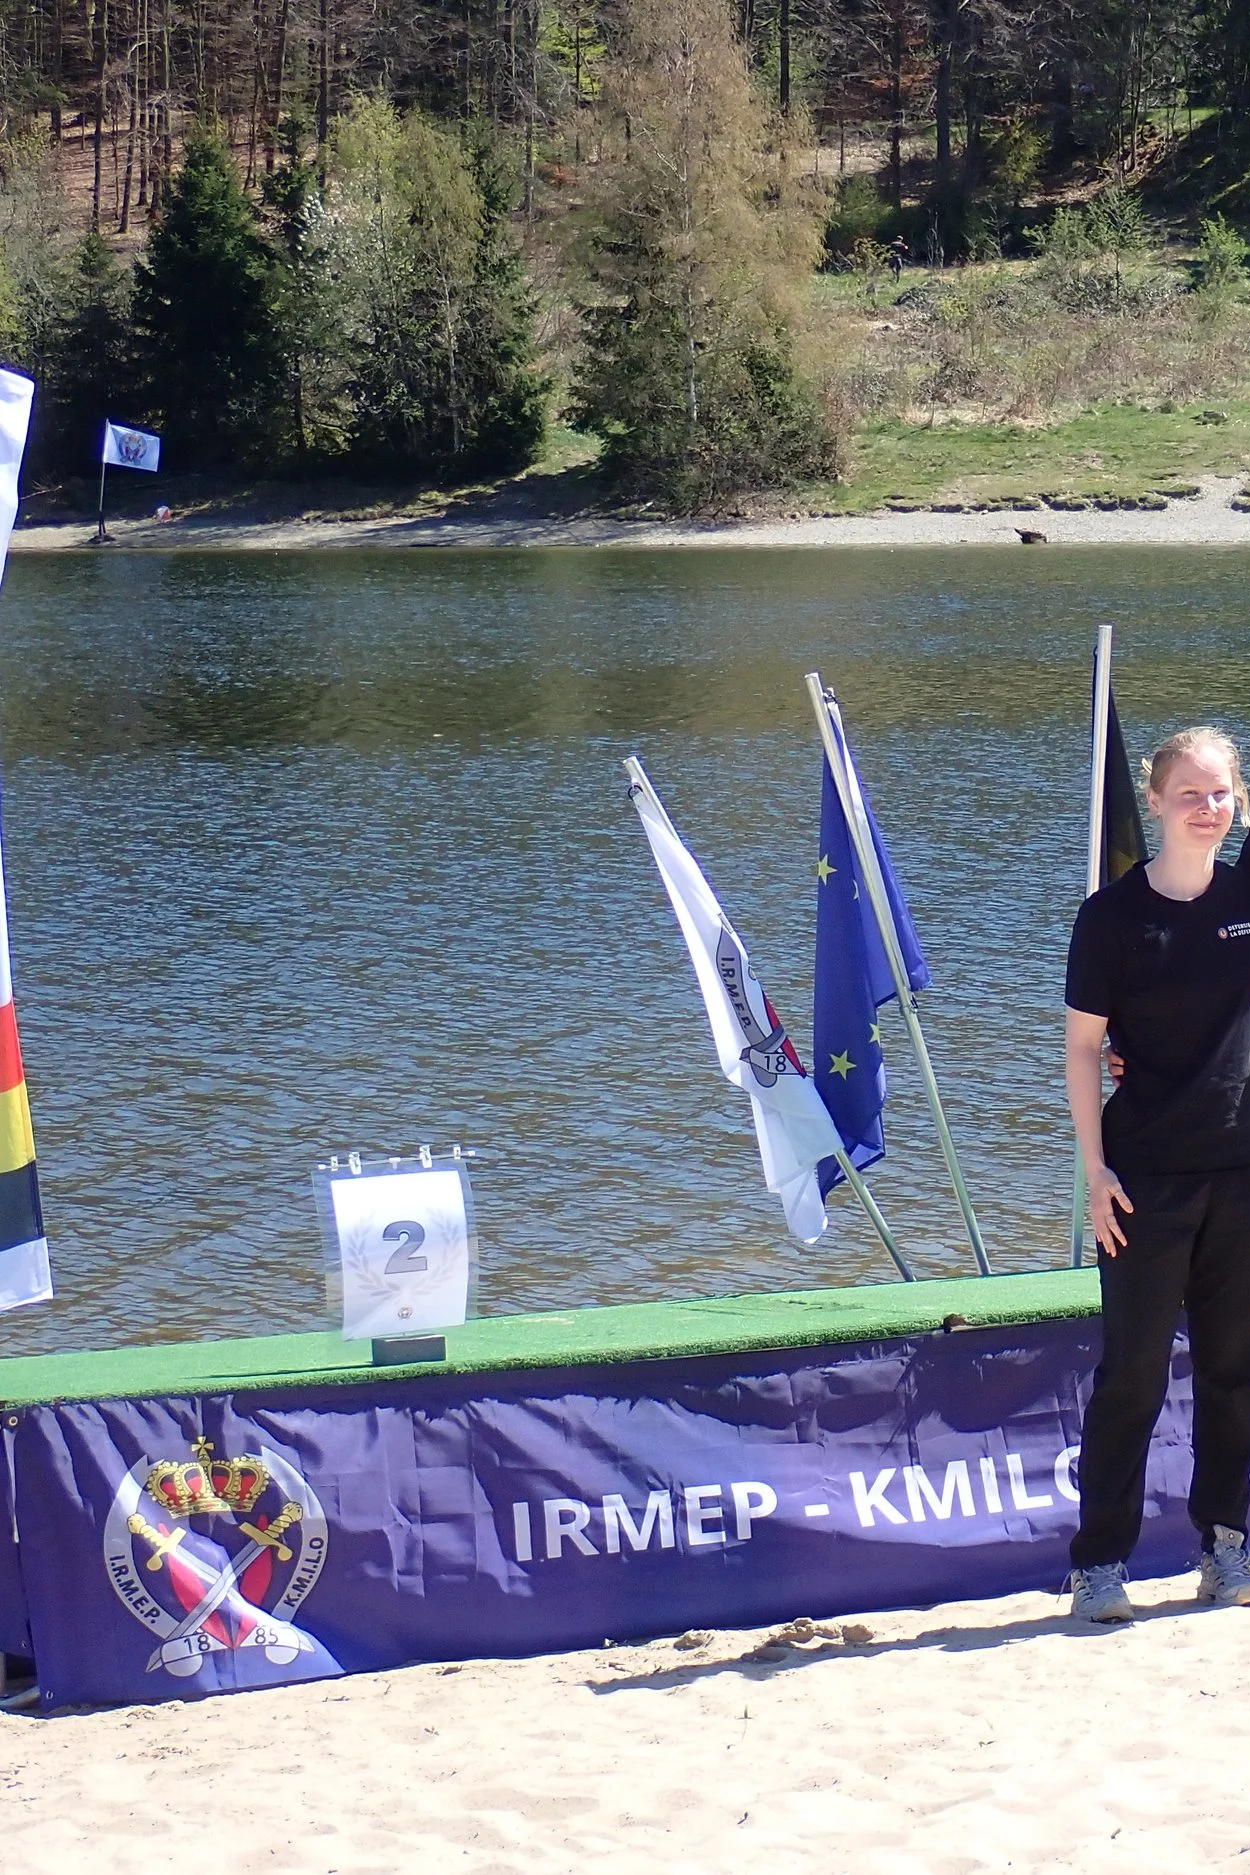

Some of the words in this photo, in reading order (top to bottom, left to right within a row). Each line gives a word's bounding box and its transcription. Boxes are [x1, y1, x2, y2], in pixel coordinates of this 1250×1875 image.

[720, 957, 752, 1029] I.R.M.E.P.
[764, 1055, 788, 1073] 18
[382, 1219, 428, 1275] 2
[511, 1480, 779, 1562] IRMEP
[109, 1554, 161, 1624] I.R.M.E.P.
[183, 1634, 211, 1655] 18
[254, 1626, 279, 1646] 85
